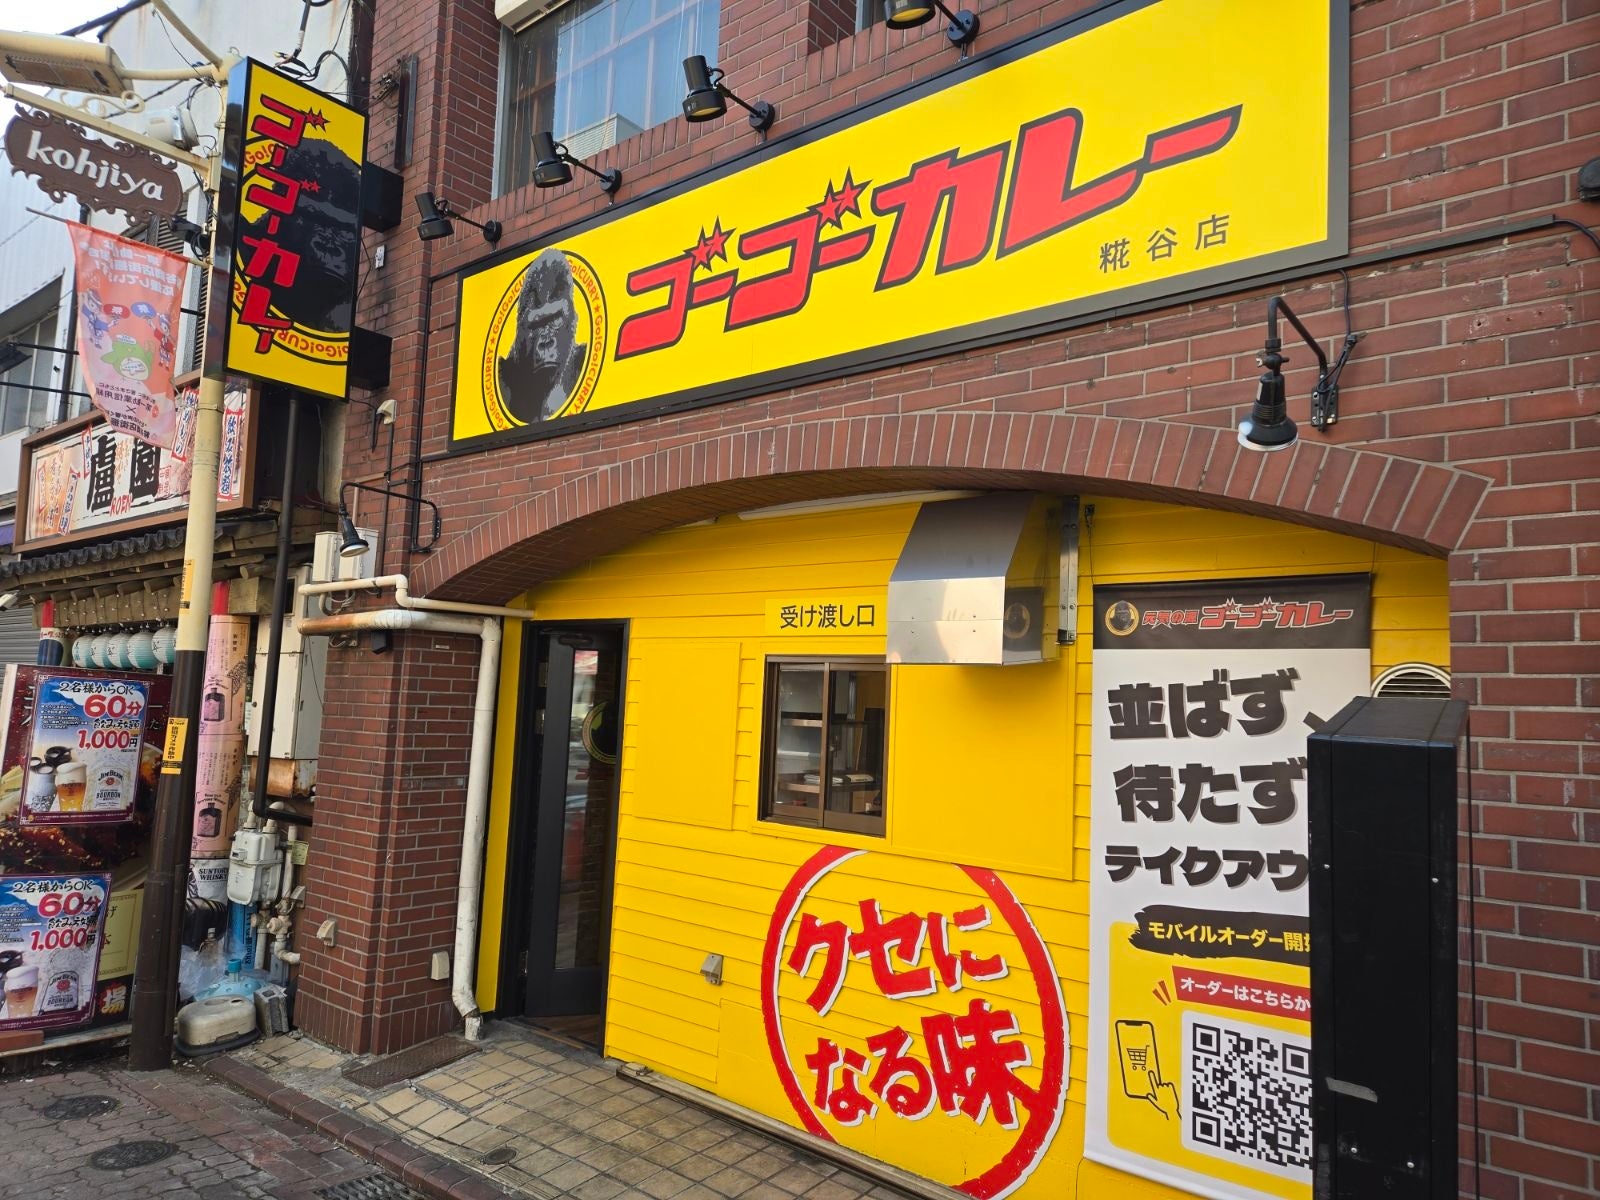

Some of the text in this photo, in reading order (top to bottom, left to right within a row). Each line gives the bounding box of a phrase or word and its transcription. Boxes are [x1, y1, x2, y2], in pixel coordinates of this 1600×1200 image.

[27, 130, 164, 201] kohjiya
[238, 93, 330, 354] ゴーゴーカレー
[613, 103, 1244, 362] ゴーゴーカレー
[1098, 213, 1230, 274] 糀谷店
[780, 603, 875, 629] 受け渡し口
[1199, 596, 1354, 630] ゴーゴーカレー
[83, 693, 142, 719] 60分
[77, 729, 138, 750] 1,000円
[1113, 757, 1307, 824] 待たず
[31, 928, 96, 950] 1,000円
[787, 898, 1009, 1017] クセに
[1180, 977, 1311, 1012] オーダーはこちらか
[805, 998, 1032, 1130] なる味
